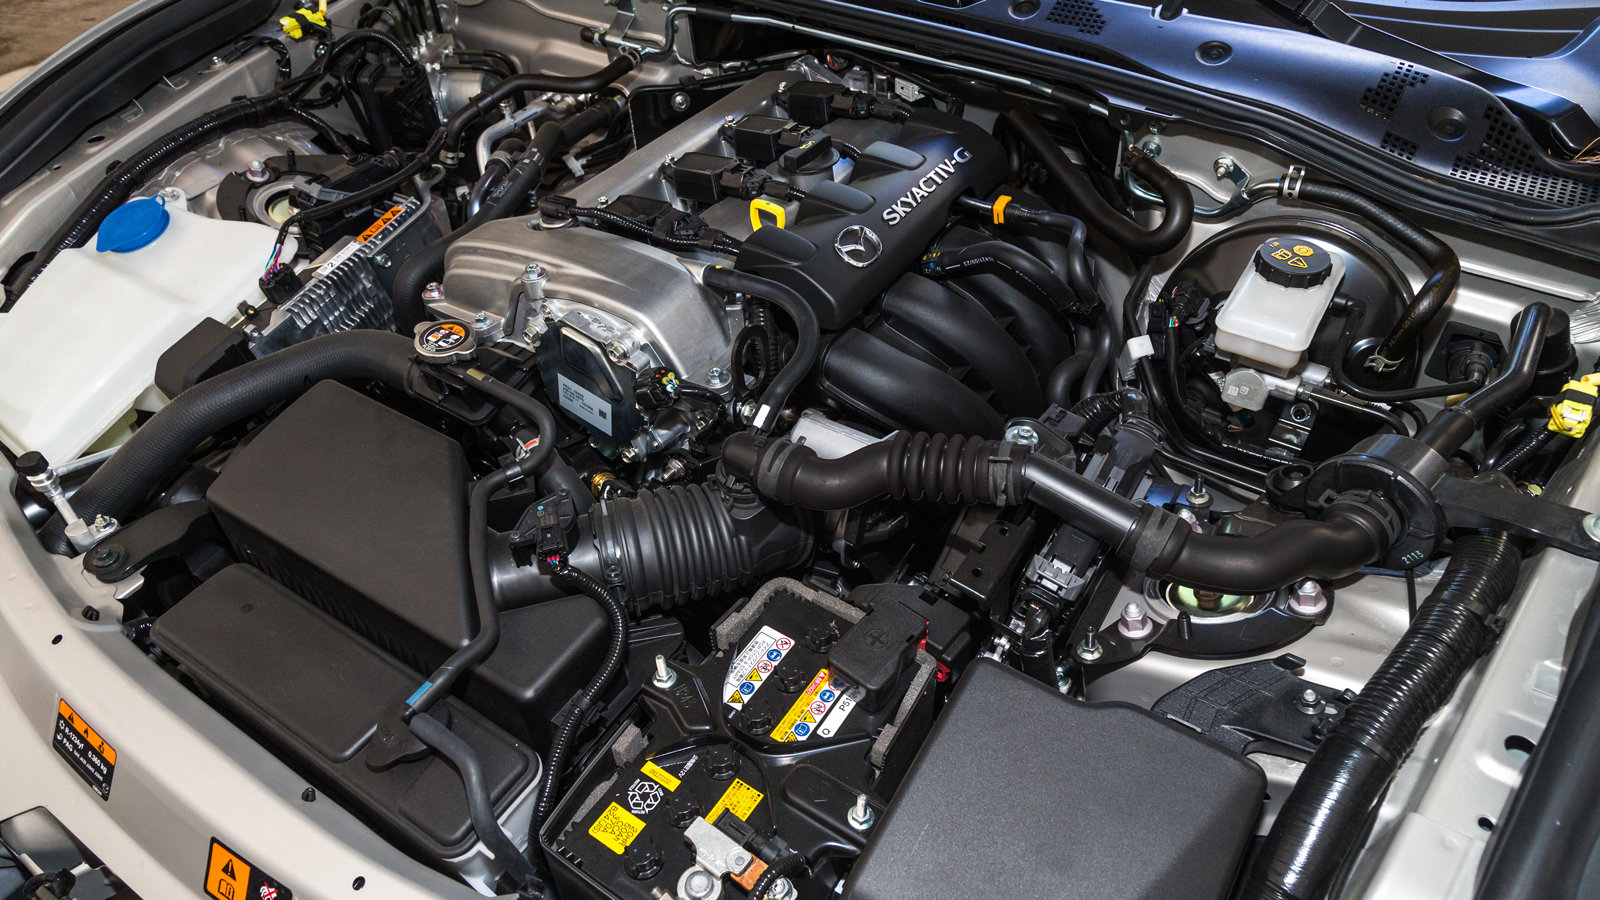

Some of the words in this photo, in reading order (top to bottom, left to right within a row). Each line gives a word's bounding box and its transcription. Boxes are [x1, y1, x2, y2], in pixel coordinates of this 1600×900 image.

[882, 147, 972, 226] SKYACTIV-G
[1402, 550, 1423, 565] 2113
[748, 650, 758, 661] STOP
[732, 665, 745, 679] START
[63, 737, 73, 751] PAG
[592, 805, 618, 834] B24(JIS)
[601, 814, 620, 833] 370A
[609, 820, 623, 835] CCA
[613, 822, 631, 841] 50Ah
[619, 826, 638, 846] 20HR
